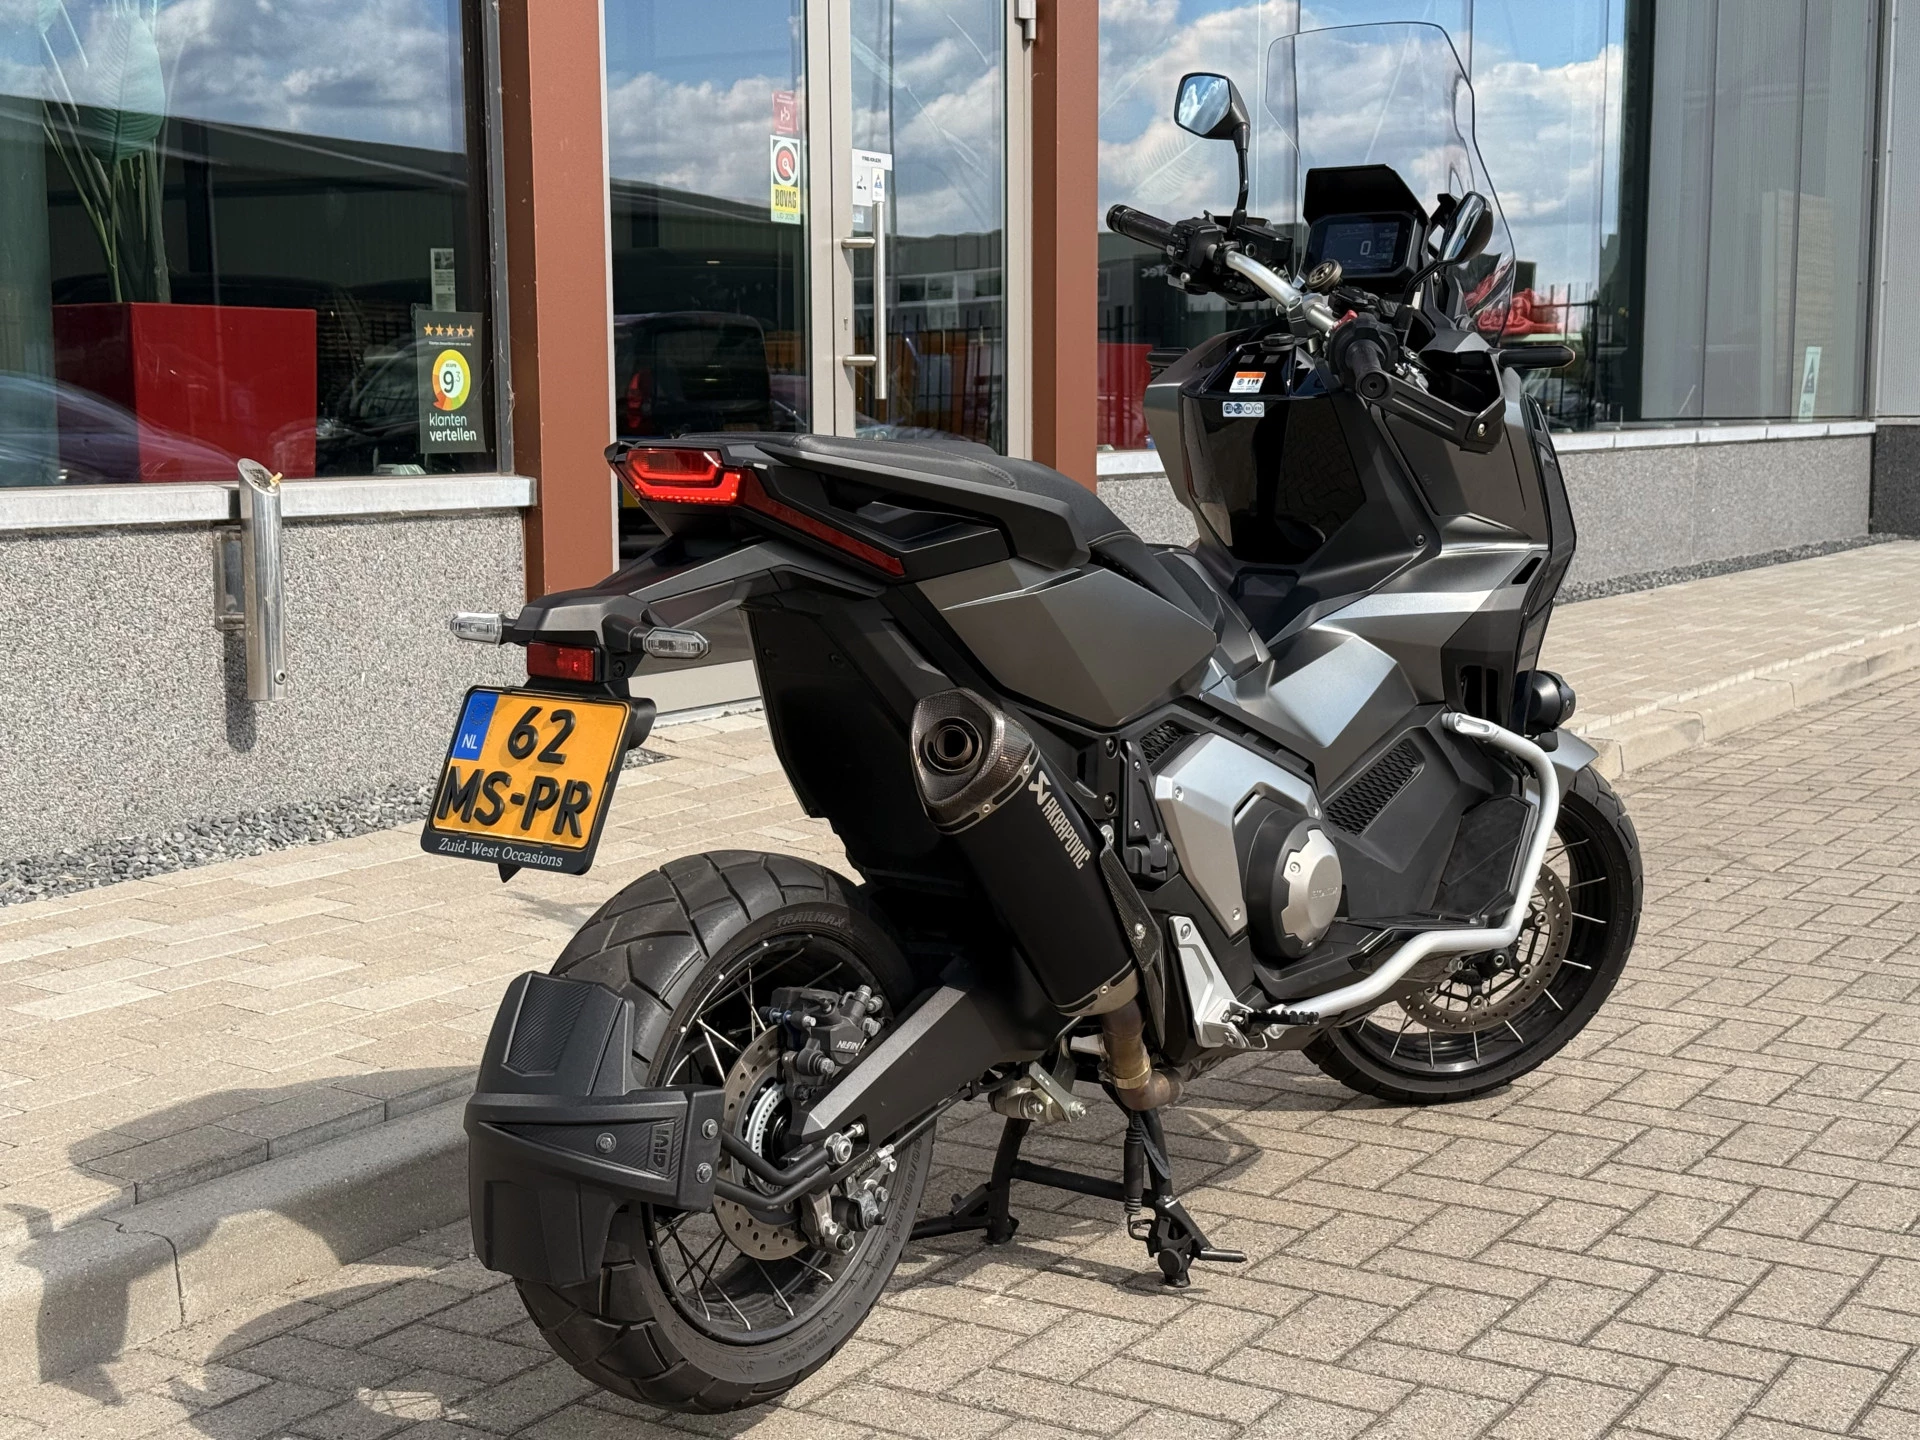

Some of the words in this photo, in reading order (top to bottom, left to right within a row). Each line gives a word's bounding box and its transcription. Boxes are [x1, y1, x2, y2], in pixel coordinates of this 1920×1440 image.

[775, 189, 797, 209] BOVAG
[1360, 240, 1371, 255] 0
[443, 370, 455, 393] 9
[429, 412, 468, 427] klanten
[429, 428, 477, 442] vertellen
[461, 733, 478, 750] NL
[507, 705, 576, 765] 62
[436, 765, 593, 839] MS-PR
[438, 837, 500, 859] Zuid-West
[502, 846, 564, 867] Occasions
[653, 1129, 669, 1168] GIVI
